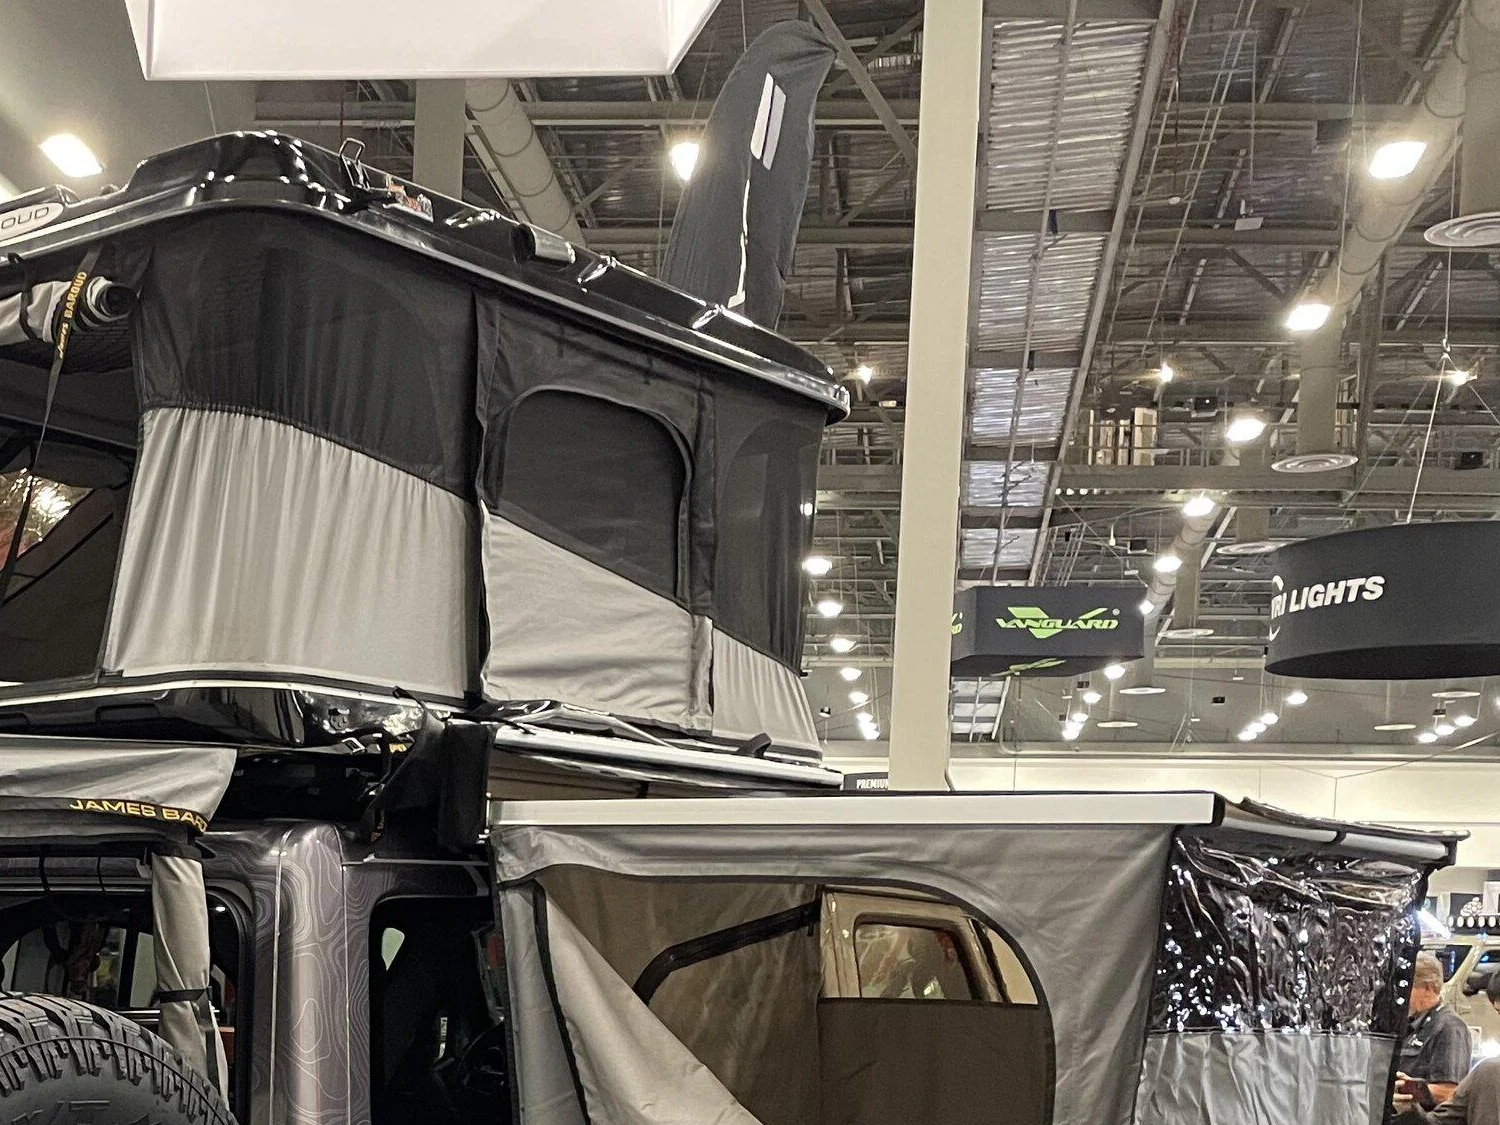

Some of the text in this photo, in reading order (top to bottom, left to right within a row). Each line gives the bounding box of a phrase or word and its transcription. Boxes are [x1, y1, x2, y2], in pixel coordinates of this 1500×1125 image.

[64, 271, 87, 319] BAROUD
[1288, 575, 1386, 613] LIGHTS
[995, 617, 1120, 630] VANGUARD
[69, 800, 157, 818] JAMES
